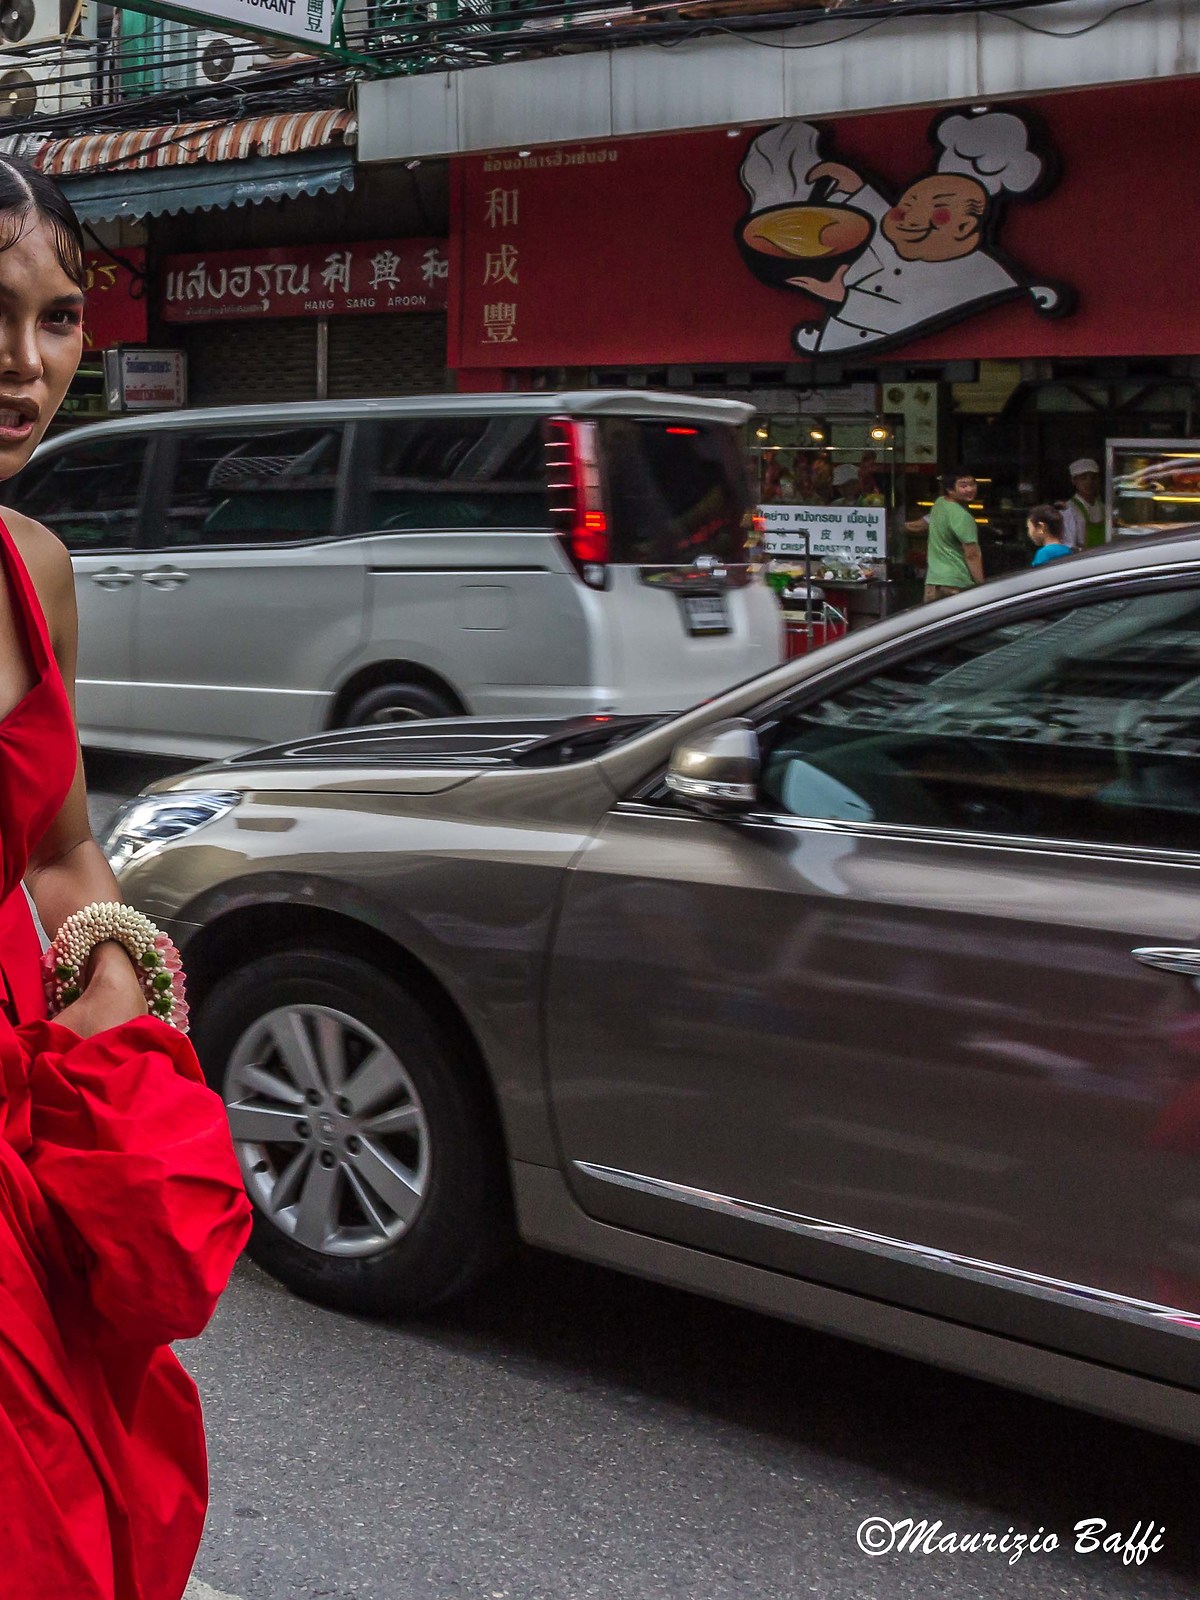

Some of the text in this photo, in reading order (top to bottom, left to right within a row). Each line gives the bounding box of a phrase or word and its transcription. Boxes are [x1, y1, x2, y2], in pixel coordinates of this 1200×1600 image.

[166, 261, 310, 312] แสงอรุณ
[304, 295, 427, 310] HANG SANG AROON
[847, 509, 879, 528] เนื้อนุ่ม
[780, 543, 805, 551] CRISP
[855, 546, 878, 554] DUCK
